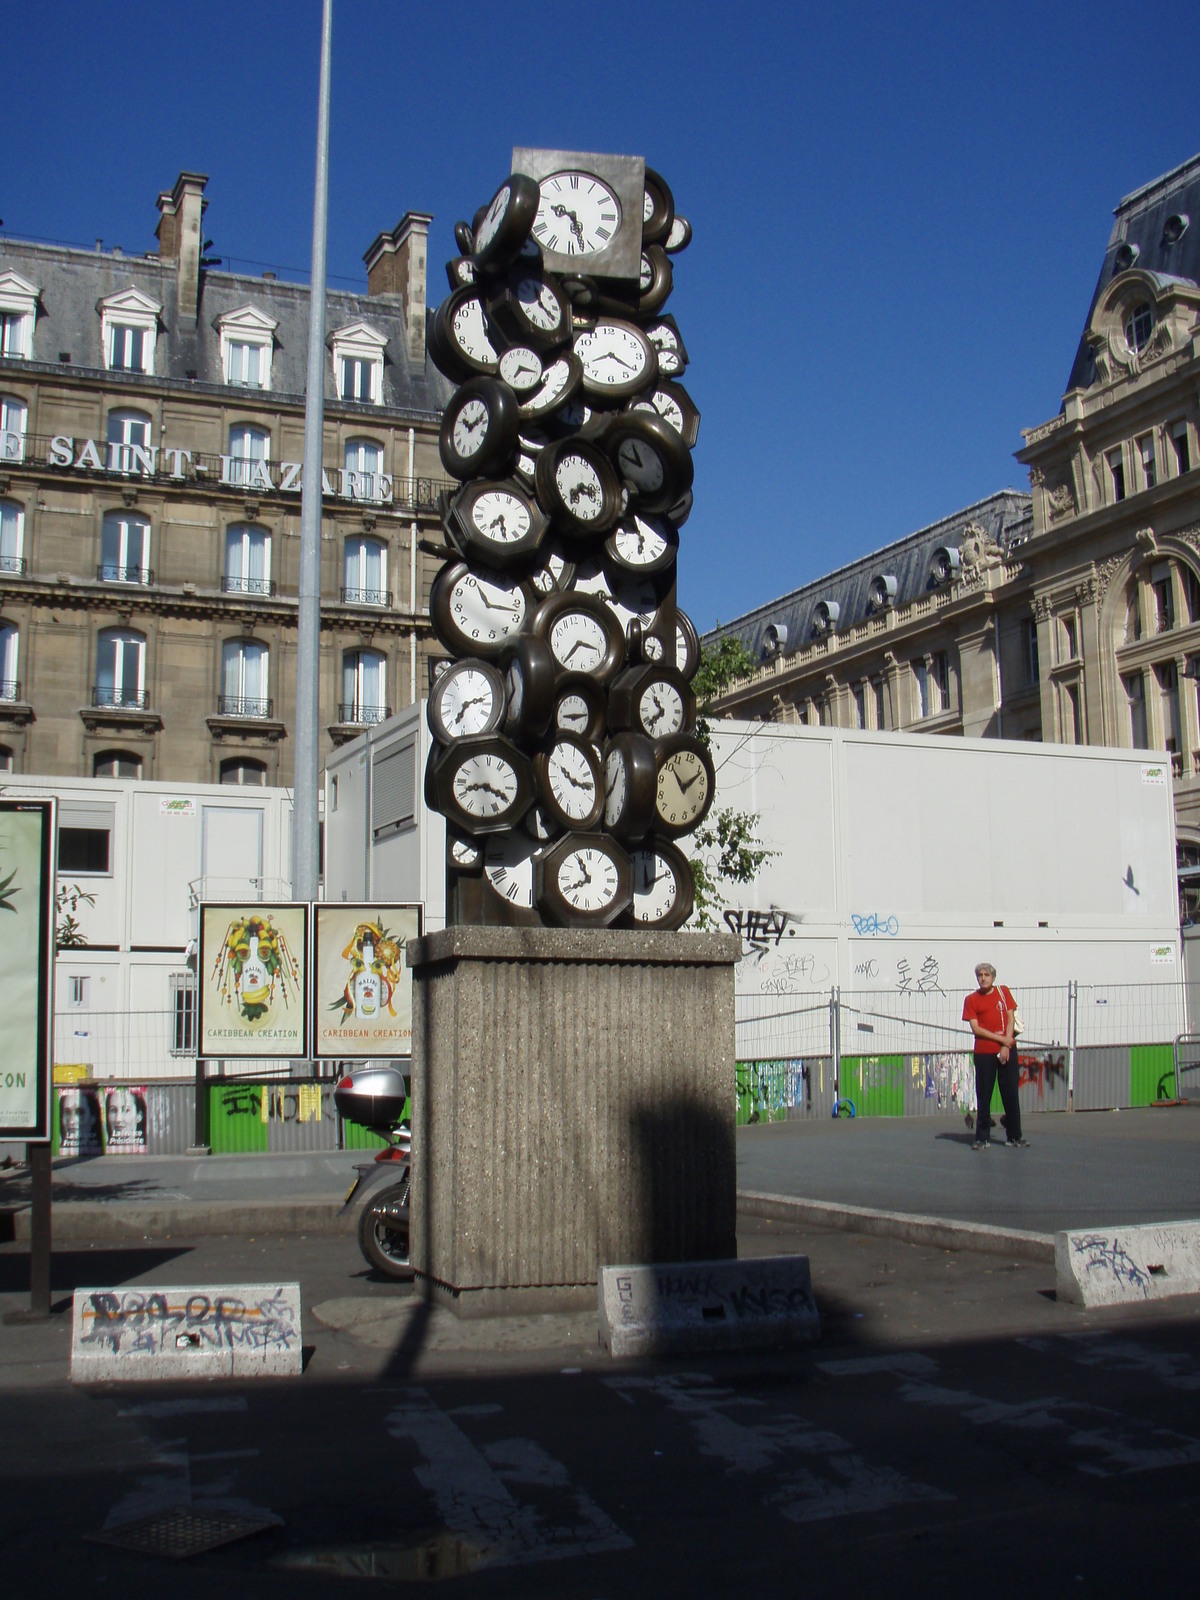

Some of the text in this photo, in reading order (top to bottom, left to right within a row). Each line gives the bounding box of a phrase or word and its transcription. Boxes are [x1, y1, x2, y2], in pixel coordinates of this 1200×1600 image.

[458, 309, 469, 318] 10
[454, 322, 461, 330] 9
[459, 336, 466, 345] 8
[467, 346, 474, 355] 7
[481, 354, 488, 363] 6
[591, 370, 599, 378] 7
[622, 371, 630, 379] 5
[607, 375, 615, 383] 6
[464, 577, 477, 587] 10
[455, 588, 464, 597] 9
[454, 603, 463, 613] 8
[512, 599, 521, 608] 2
[460, 616, 468, 625] 7
[512, 614, 520, 623] 3
[569, 616, 579, 625] 12
[471, 629, 480, 638] 6
[488, 629, 497, 639] 5
[501, 626, 509, 635] 4
[673, 755, 682, 765] 11
[685, 753, 695, 764] 12
[664, 762, 674, 773] 10
[658, 775, 664, 784] 9
[699, 777, 705, 786] 2
[658, 791, 664, 800] 8
[698, 791, 704, 801] 3
[661, 802, 668, 812] 7
[690, 805, 697, 814] 4
[669, 812, 676, 822] 6
[681, 811, 688, 820] 5
[659, 859, 663, 868] 1
[669, 885, 676, 894] 3
[664, 899, 670, 908] 4
[656, 907, 663, 917] 5
[642, 912, 649, 922] 6
[207, 1029, 298, 1038] CARIBBEAN CREATION
[322, 1029, 412, 1038] CARIBBEAN CREATION
